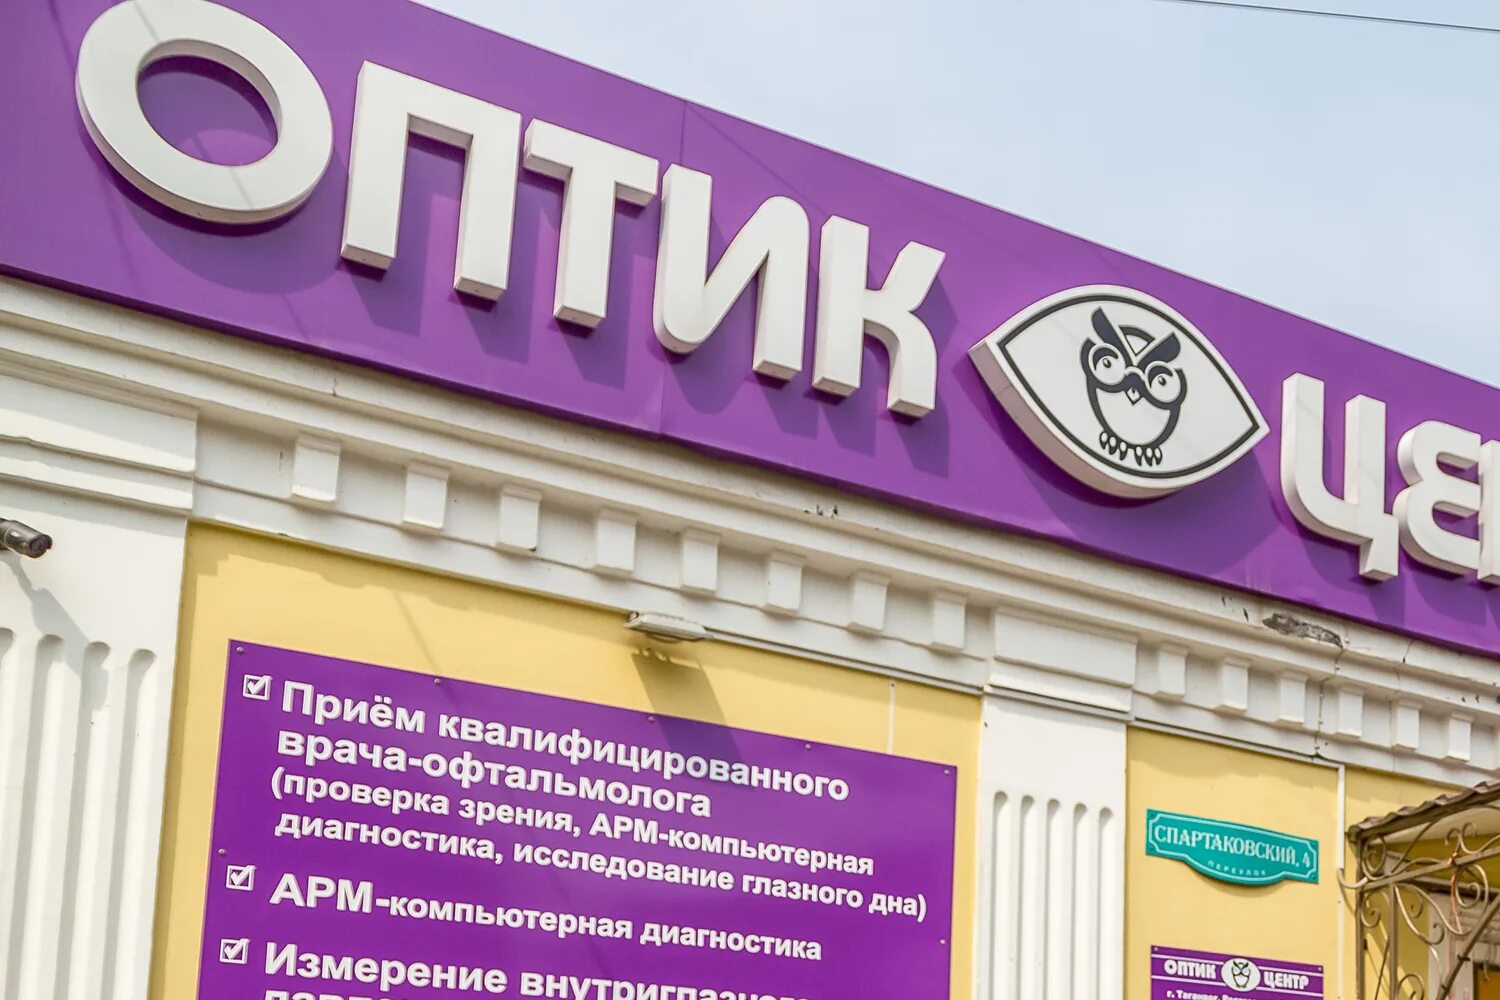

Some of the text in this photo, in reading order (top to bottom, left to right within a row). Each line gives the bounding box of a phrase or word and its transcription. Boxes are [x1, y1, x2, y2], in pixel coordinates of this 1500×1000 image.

[75, 0, 946, 419] ОПТИК
[276, 728, 712, 819] врача-офтальмолога
[281, 681, 850, 803] Приём квалифицированного
[270, 769, 874, 878] (проверка зрения, АРМ-компьютерная
[274, 813, 927, 923] диагностика, исследование глазного дна)
[1302, 852, 1310, 868] 4
[270, 874, 823, 961] АРМ-компьютерная диагностика
[264, 943, 508, 995] Измерение
[1164, 959, 1309, 991] ОПТИК ЦЕНТР
